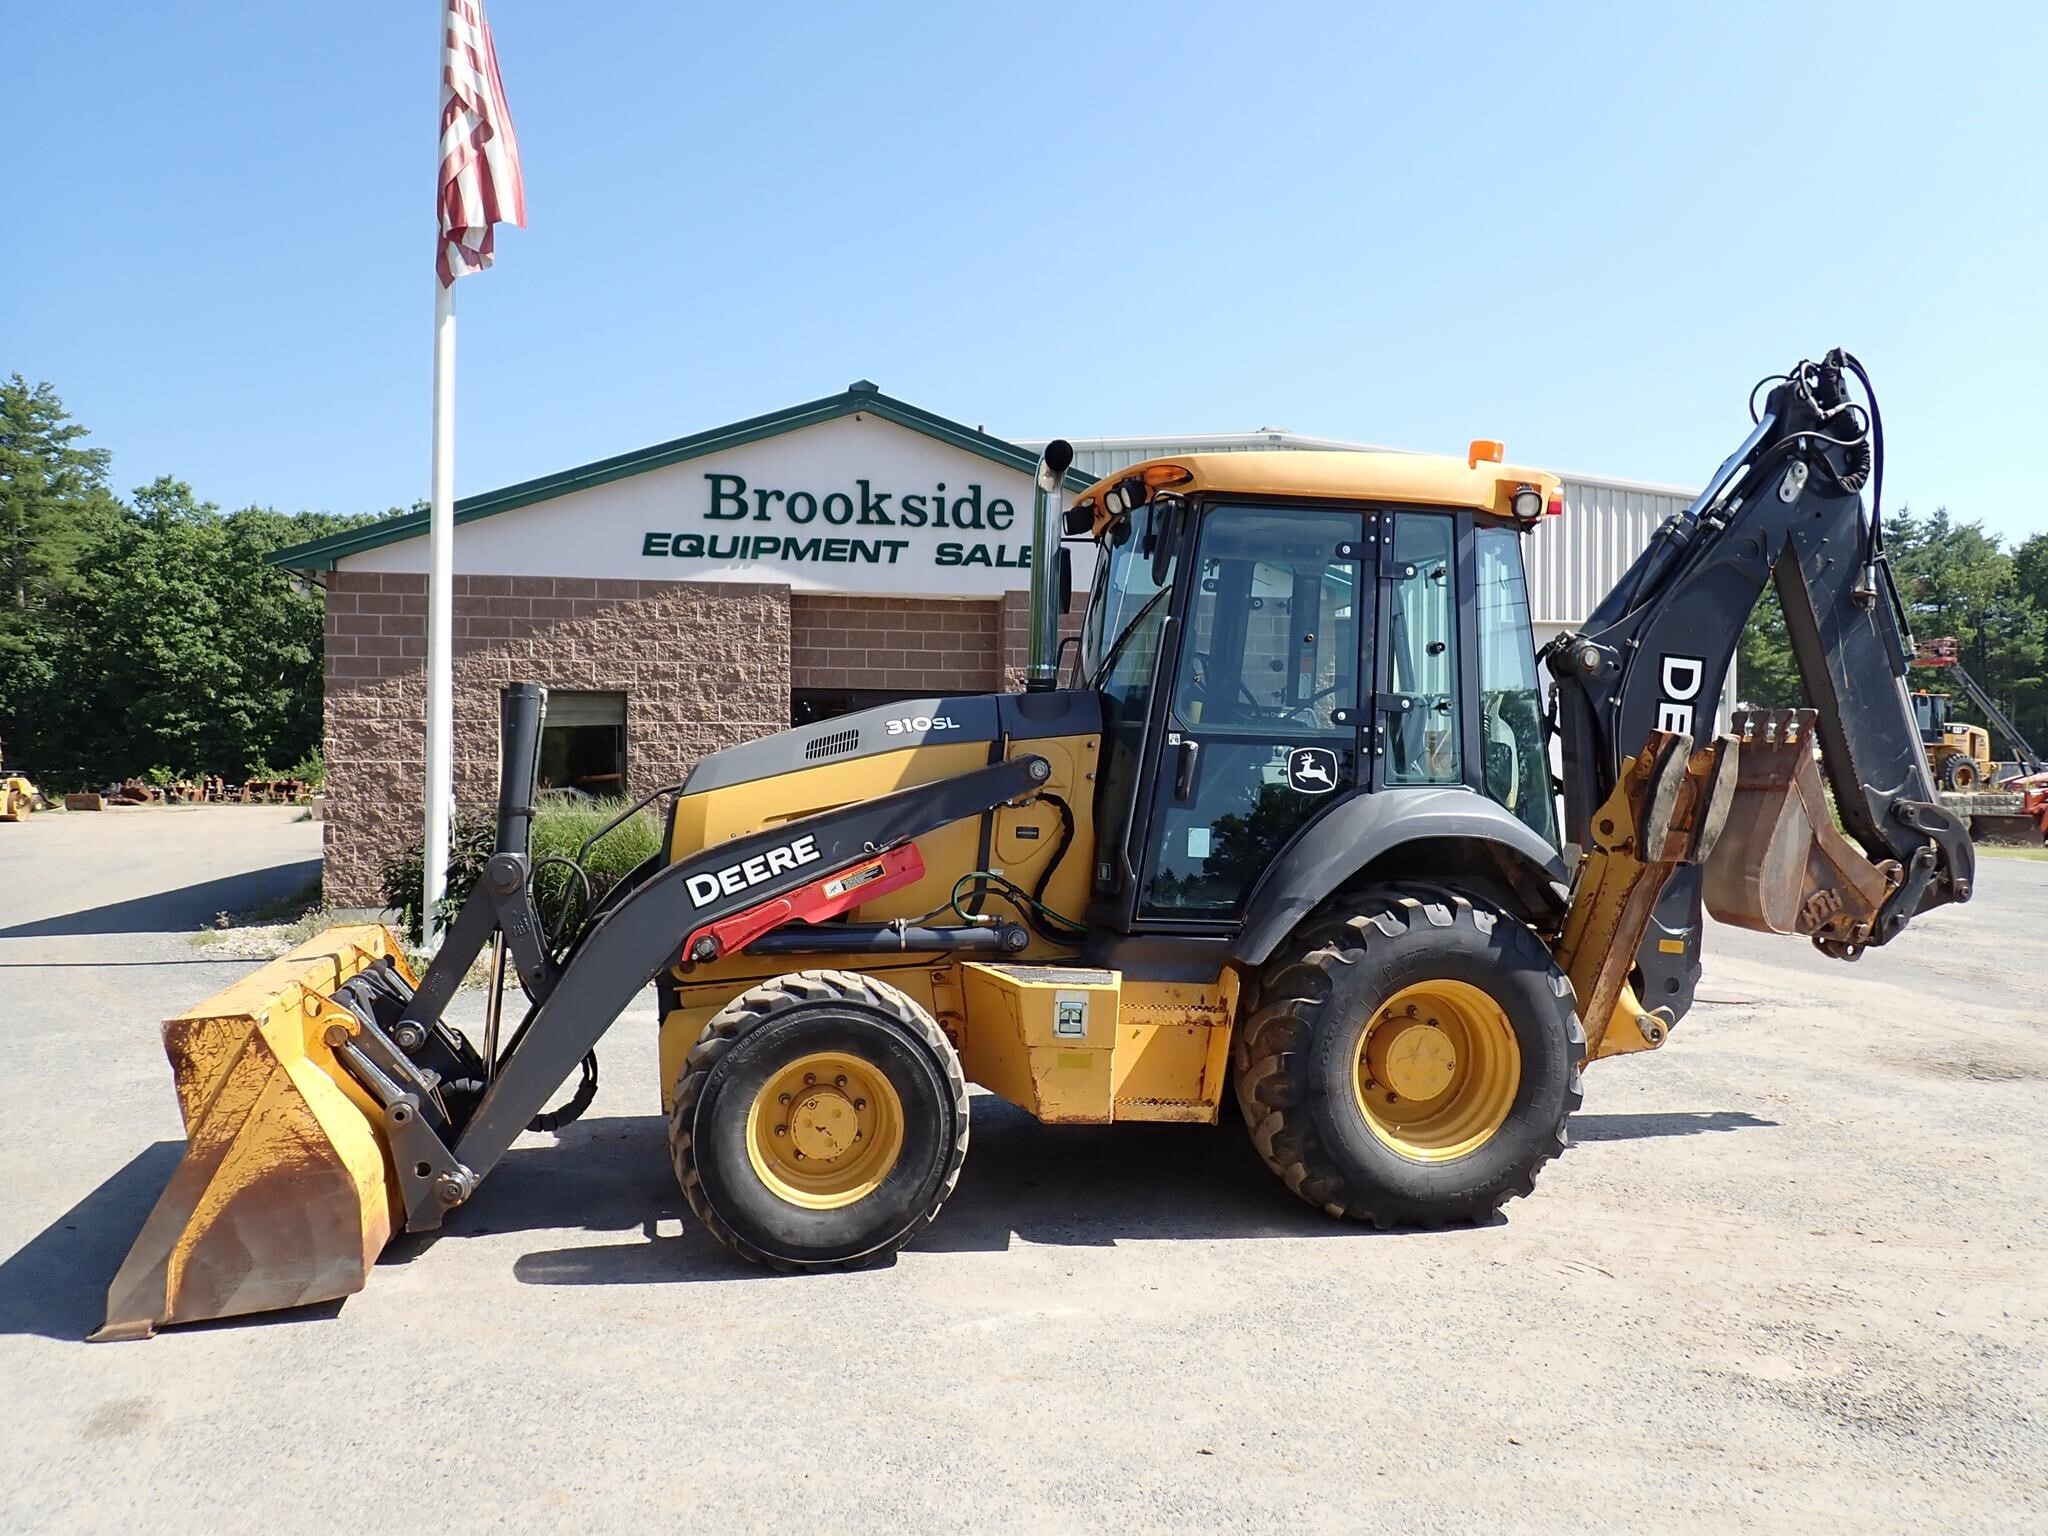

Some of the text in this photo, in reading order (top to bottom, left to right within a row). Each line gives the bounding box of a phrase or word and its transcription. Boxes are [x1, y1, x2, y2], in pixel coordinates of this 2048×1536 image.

[703, 473, 1014, 531] Brookside
[642, 532, 1032, 568] EQUIPMENT SALE
[885, 716, 960, 735] 310SL
[685, 835, 820, 908] DEERE
